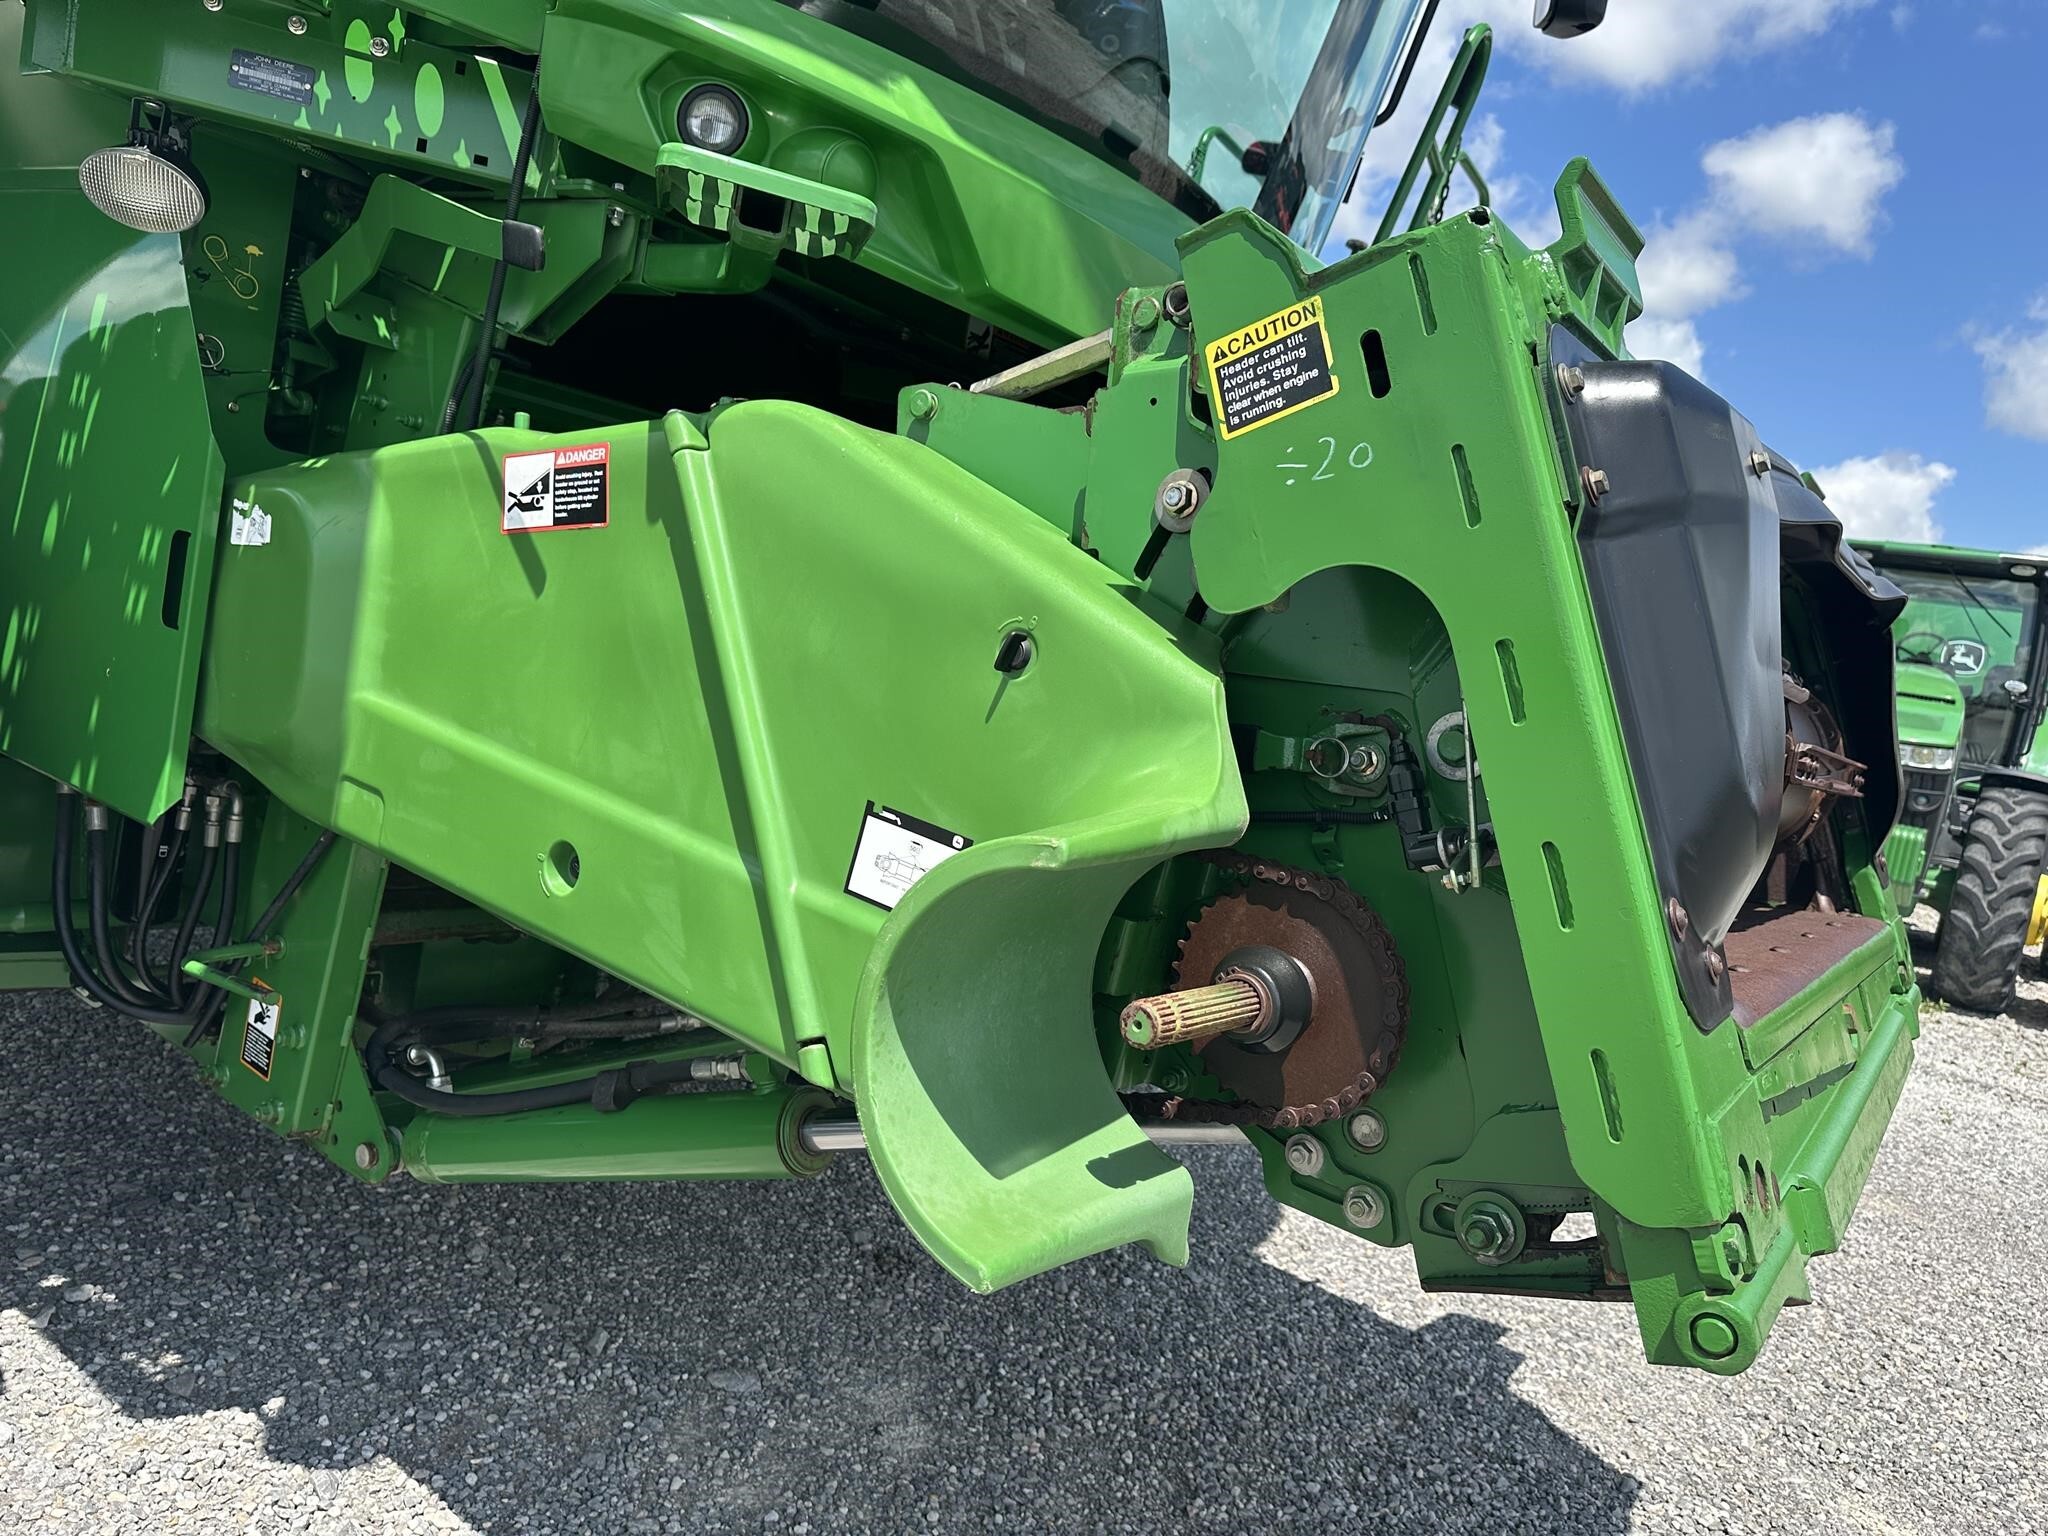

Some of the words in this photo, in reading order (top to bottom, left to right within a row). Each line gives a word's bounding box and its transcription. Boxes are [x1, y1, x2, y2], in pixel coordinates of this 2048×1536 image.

[254, 55, 272, 64] JOHN
[274, 60, 295, 70] DEERE
[1227, 302, 1317, 355] CAUTION
[1220, 353, 1260, 378] Header
[1262, 343, 1284, 359] can
[1286, 332, 1308, 348] tilt.
[1223, 367, 1254, 391] Avoid
[1256, 346, 1307, 375] crushing
[1224, 377, 1270, 402] injuries.
[1272, 363, 1299, 381] Stay
[1227, 396, 1252, 414] clear
[1253, 384, 1282, 402] when
[1283, 368, 1319, 390] engine
[1229, 415, 1240, 426] is
[1241, 396, 1286, 421] running.
[566, 448, 606, 464] DANGER
